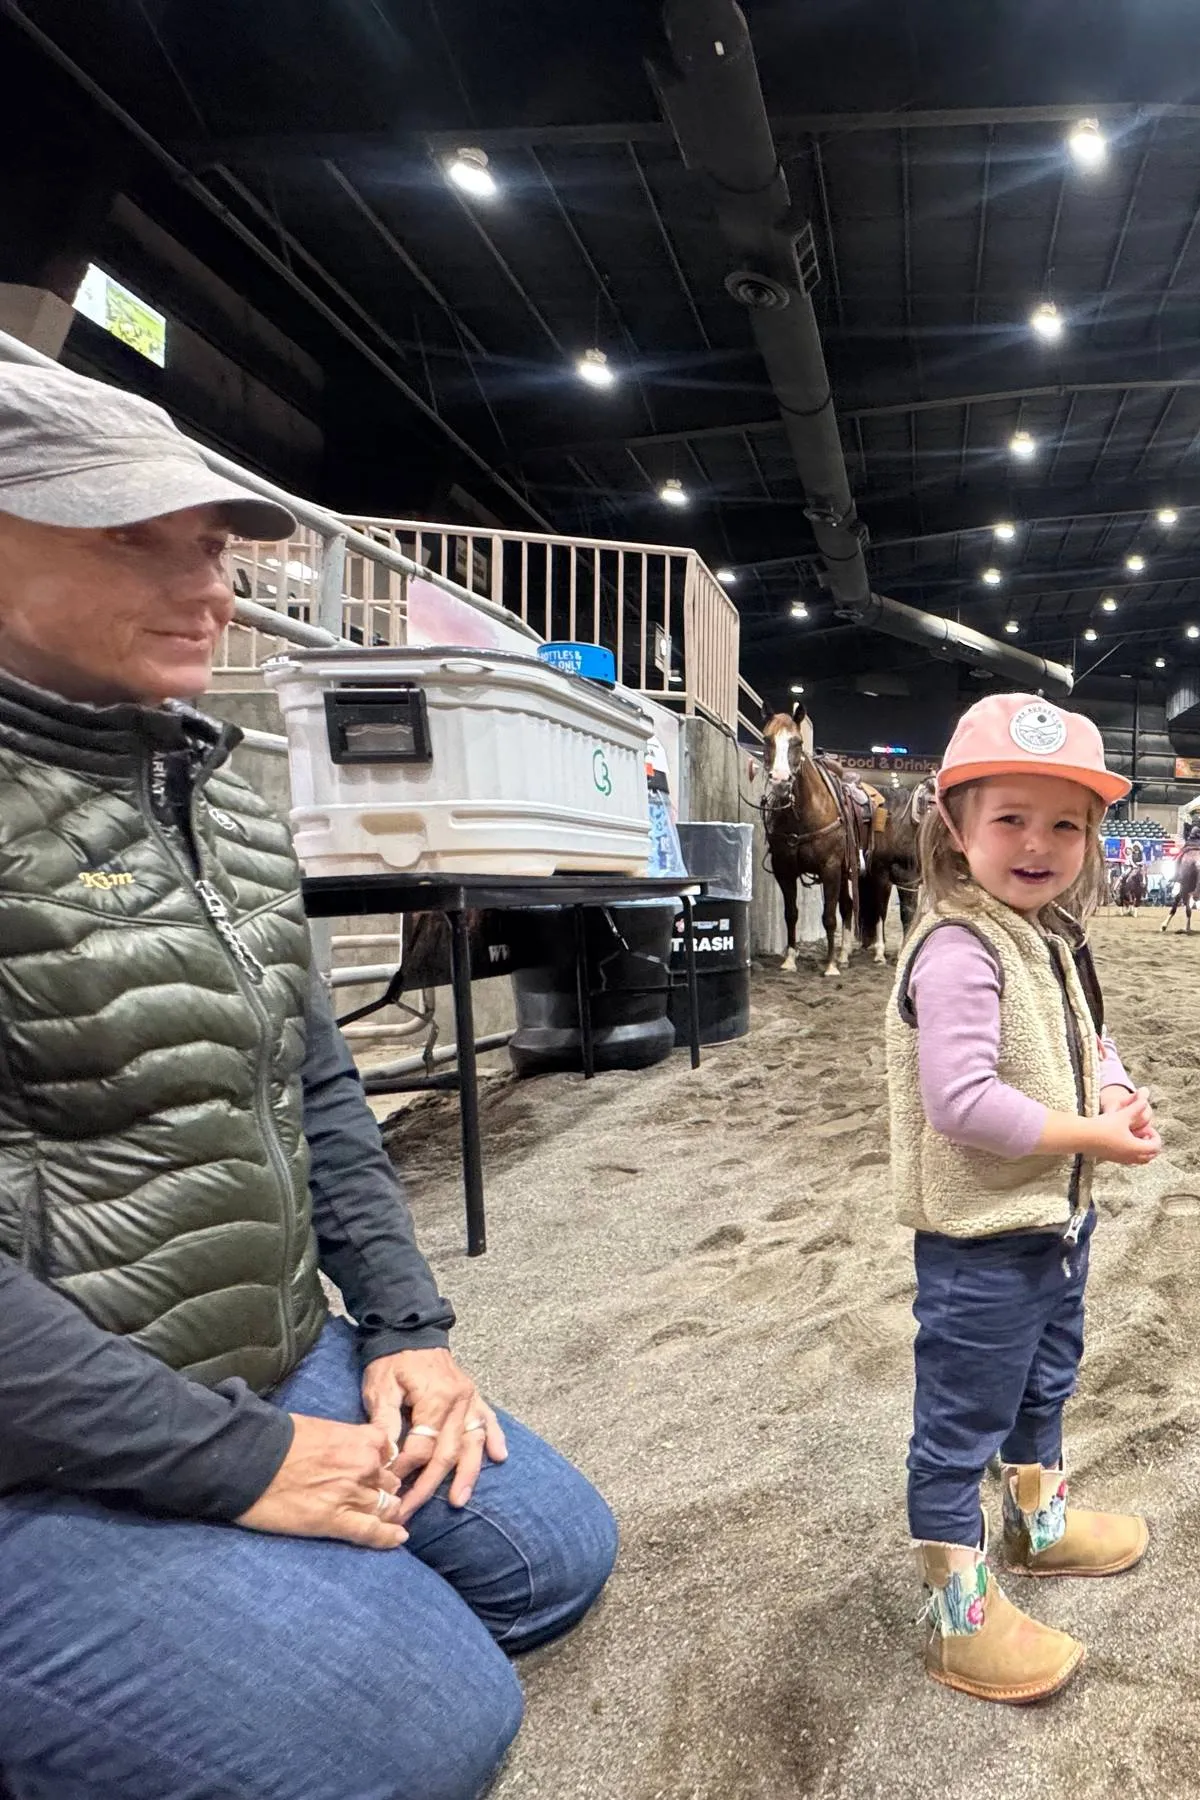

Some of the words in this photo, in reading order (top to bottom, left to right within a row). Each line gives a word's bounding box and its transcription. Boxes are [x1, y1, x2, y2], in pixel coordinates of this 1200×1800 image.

[558, 660, 582, 671] ONLY
[840, 756, 875, 769] Food
[880, 757, 889, 769] &
[79, 872, 135, 890] Kim
